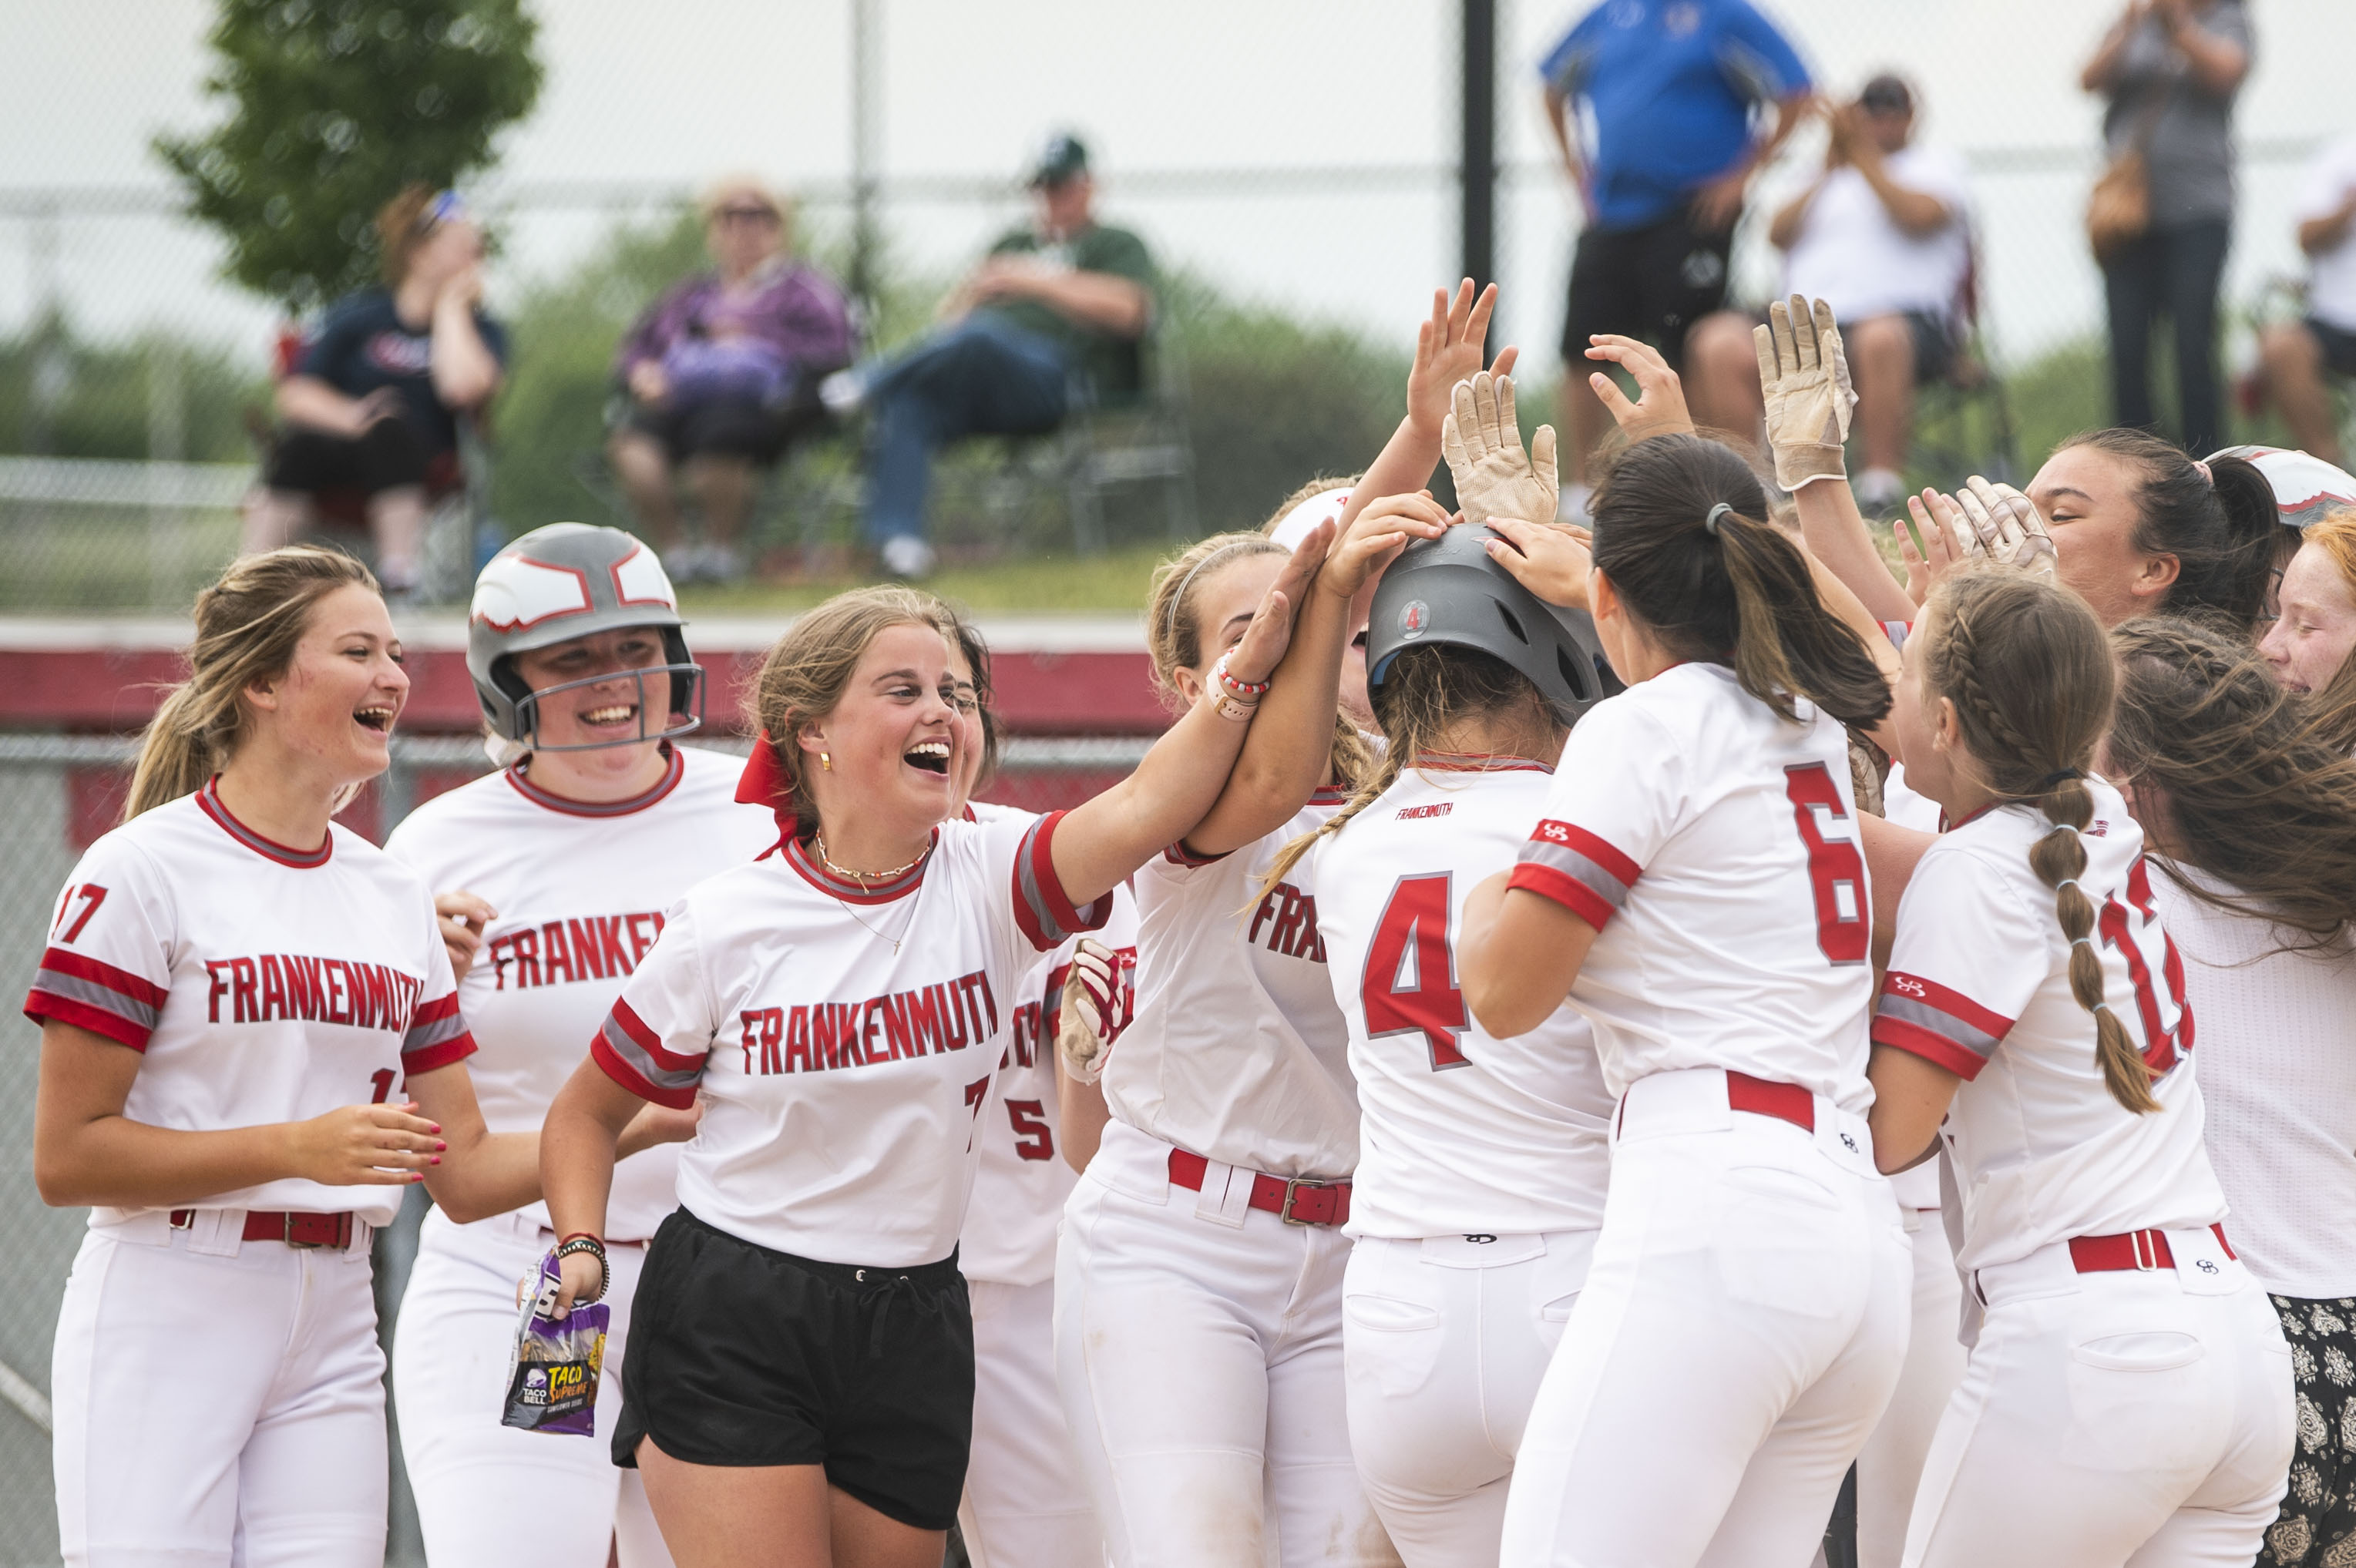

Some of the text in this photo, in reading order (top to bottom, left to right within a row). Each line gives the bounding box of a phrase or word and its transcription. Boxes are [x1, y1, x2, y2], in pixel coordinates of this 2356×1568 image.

[1406, 606, 1419, 630] 4
[1395, 802, 1454, 821] FRANKENMUTH
[1783, 760, 1867, 967] 6
[1249, 879, 1328, 963] FRA
[1360, 870, 1473, 1073] 4
[1004, 1099, 1054, 1160] 5
[548, 1366, 583, 1390] TACO
[523, 1388, 547, 1398] TACO
[524, 1395, 546, 1405] BELL
